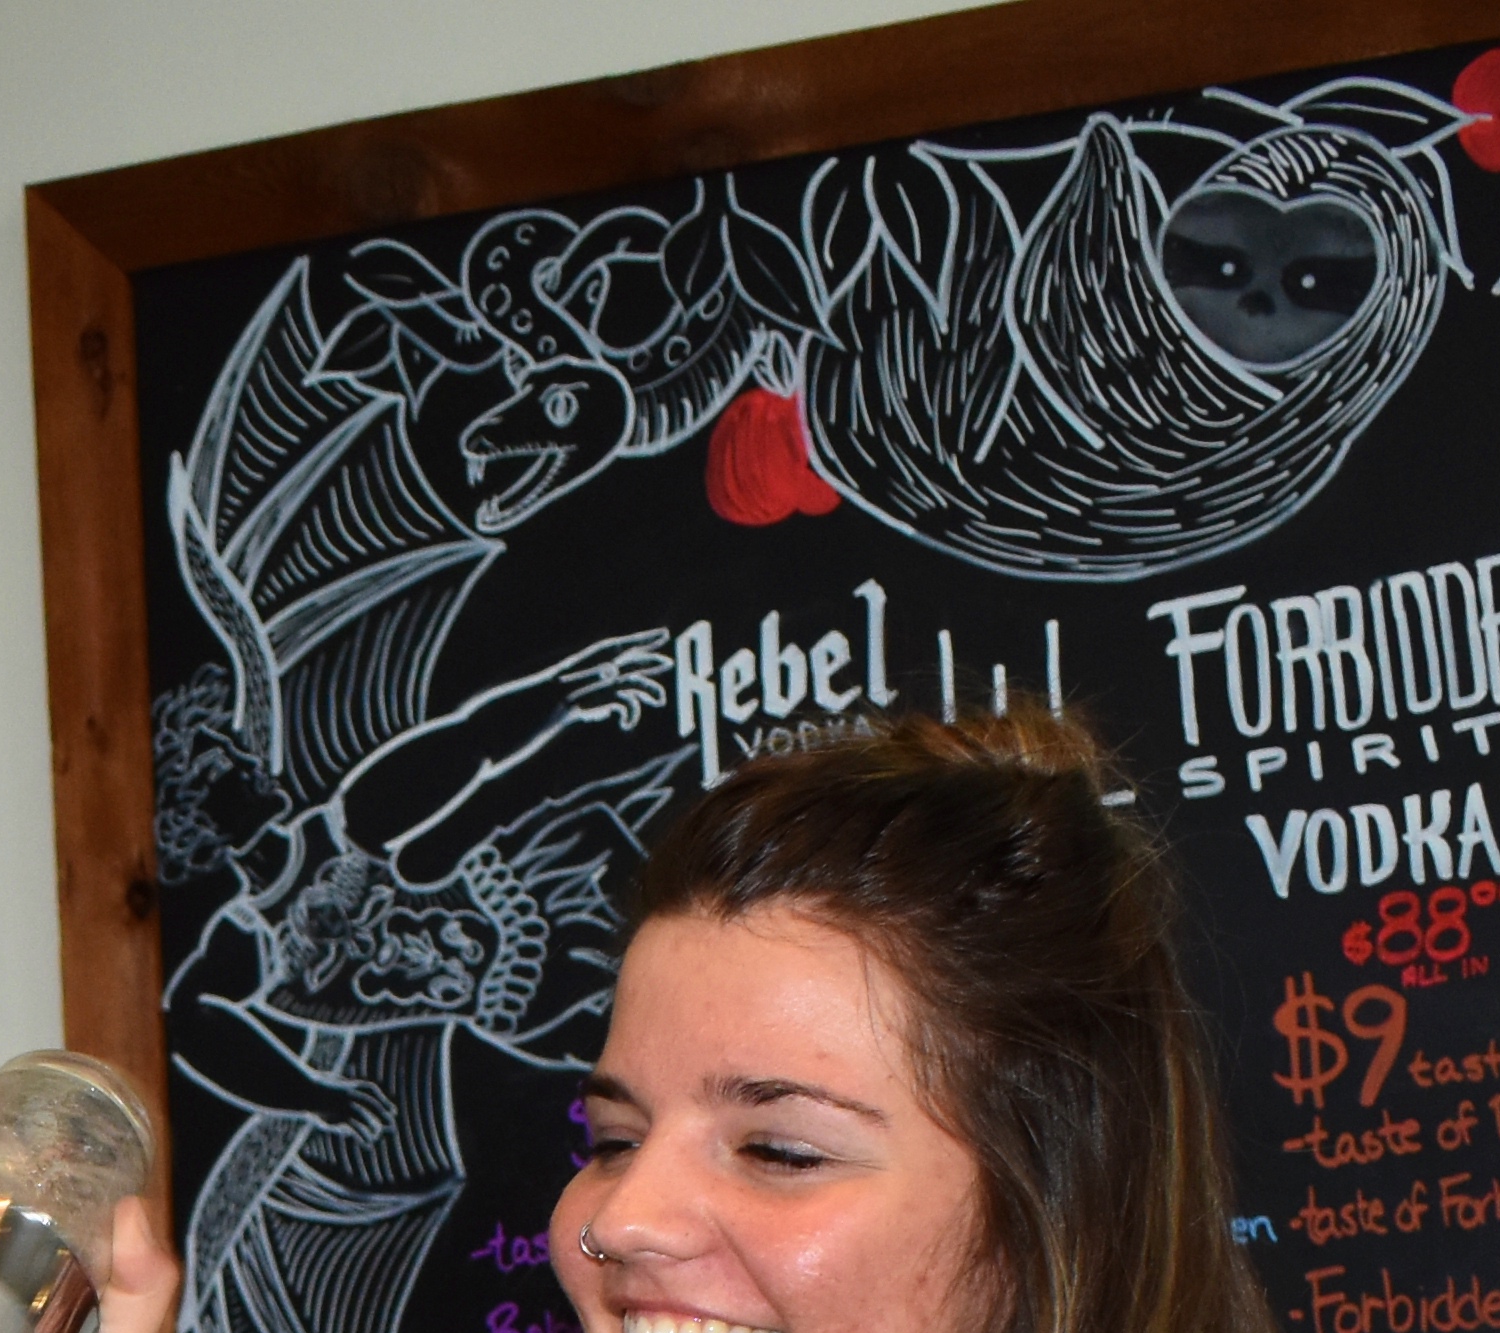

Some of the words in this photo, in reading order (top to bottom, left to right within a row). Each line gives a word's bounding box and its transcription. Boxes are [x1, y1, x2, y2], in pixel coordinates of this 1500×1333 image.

[675, 578, 899, 791] Rebel
[1400, 963, 1449, 988] ALL
[1461, 955, 1490, 978] IN
[1271, 970, 1408, 1109] $9
[1436, 1099, 1479, 1151] of
[1394, 1180, 1429, 1234] of
